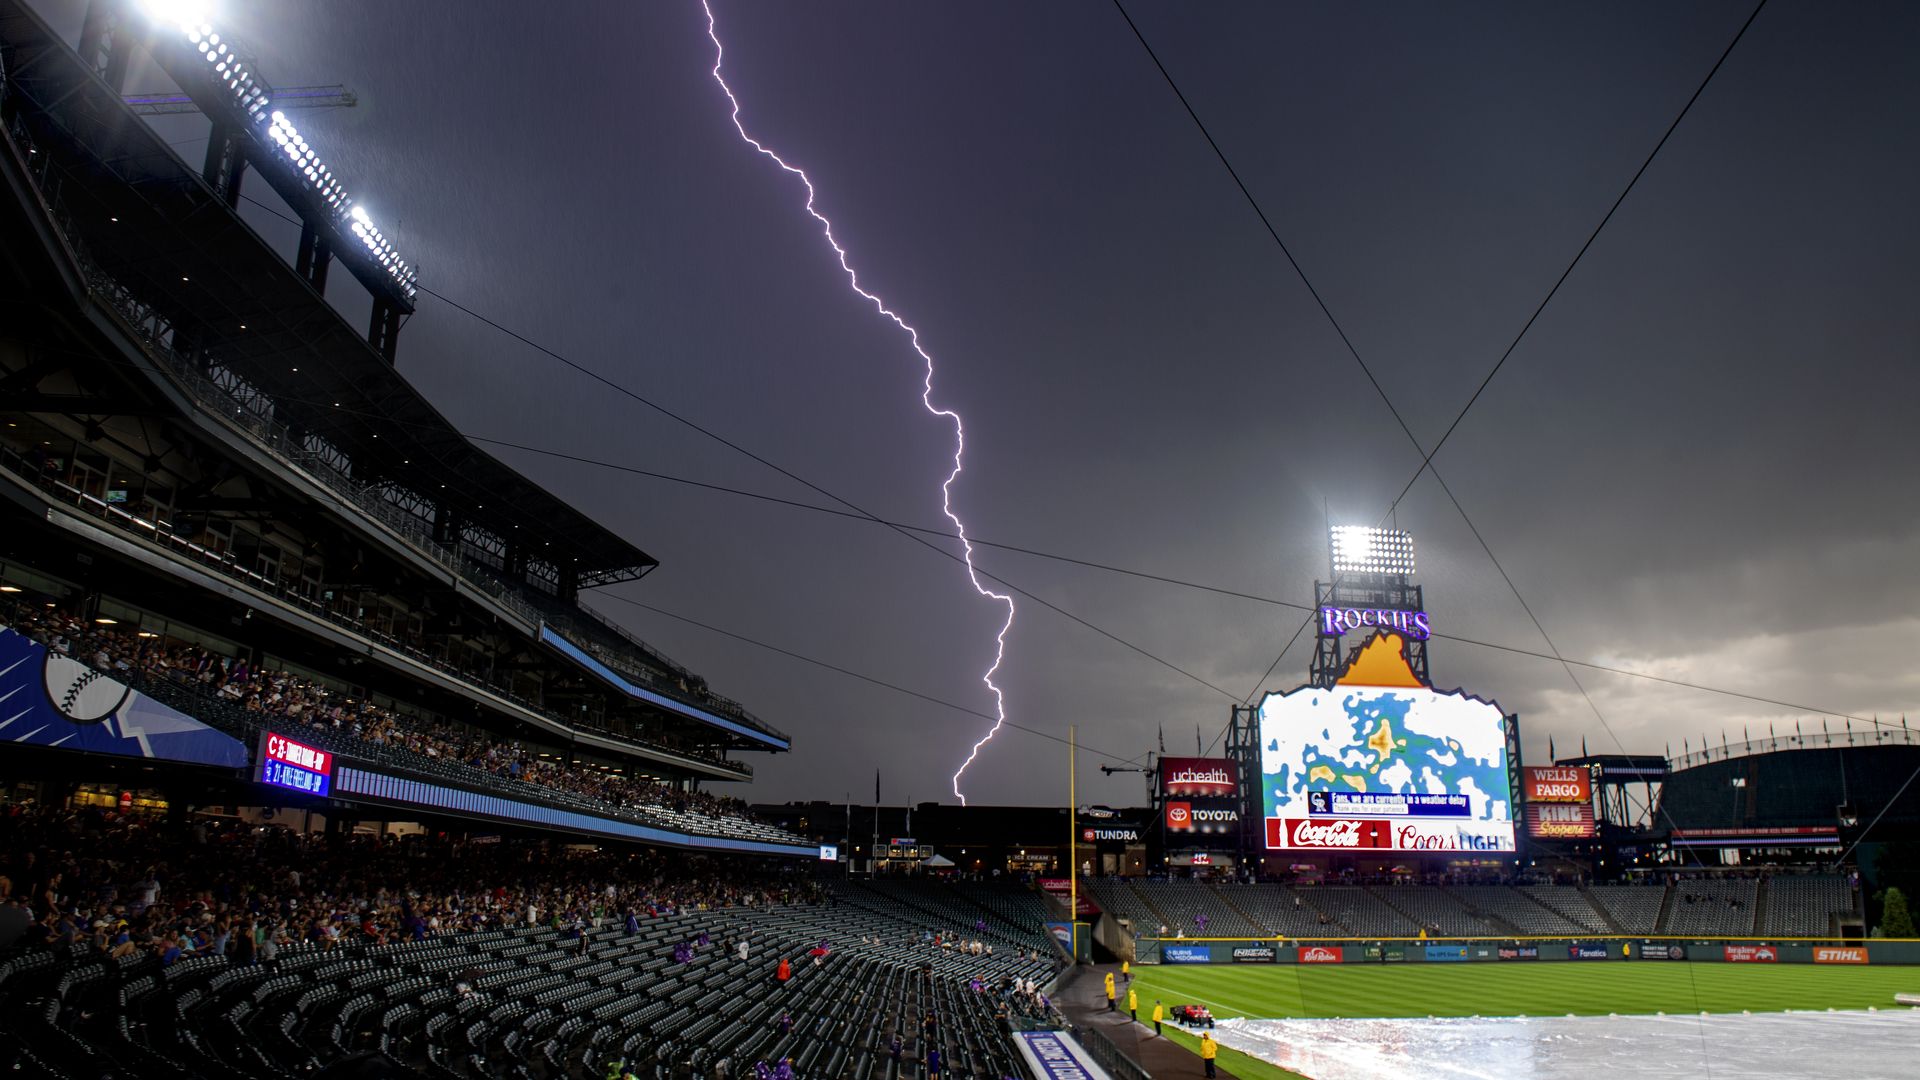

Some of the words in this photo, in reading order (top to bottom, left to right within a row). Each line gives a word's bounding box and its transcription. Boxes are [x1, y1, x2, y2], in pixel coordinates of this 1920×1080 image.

[1321, 607, 1431, 640] ROCKIES
[1173, 767, 1229, 783] uchealth
[1533, 769, 1578, 781] WELLS
[1536, 784, 1580, 797] FARGO
[1350, 795, 1361, 803] we
[1363, 795, 1374, 803] are
[1375, 794, 1405, 804] currently
[1407, 794, 1413, 804] in
[1420, 794, 1447, 804] weather
[1448, 794, 1467, 807] delay
[1191, 810, 1238, 820] TOYOTA
[1538, 805, 1582, 821] KING
[1094, 830, 1138, 840] TUNDRA
[1293, 820, 1362, 847] Coca-Cola
[1539, 821, 1585, 837] Soopers
[1398, 825, 1456, 849] Coors
[1579, 949, 1607, 958] Fanatics
[1727, 946, 1757, 954] brakes
[1818, 950, 1862, 960] STIHL
[1731, 953, 1750, 961] plus
